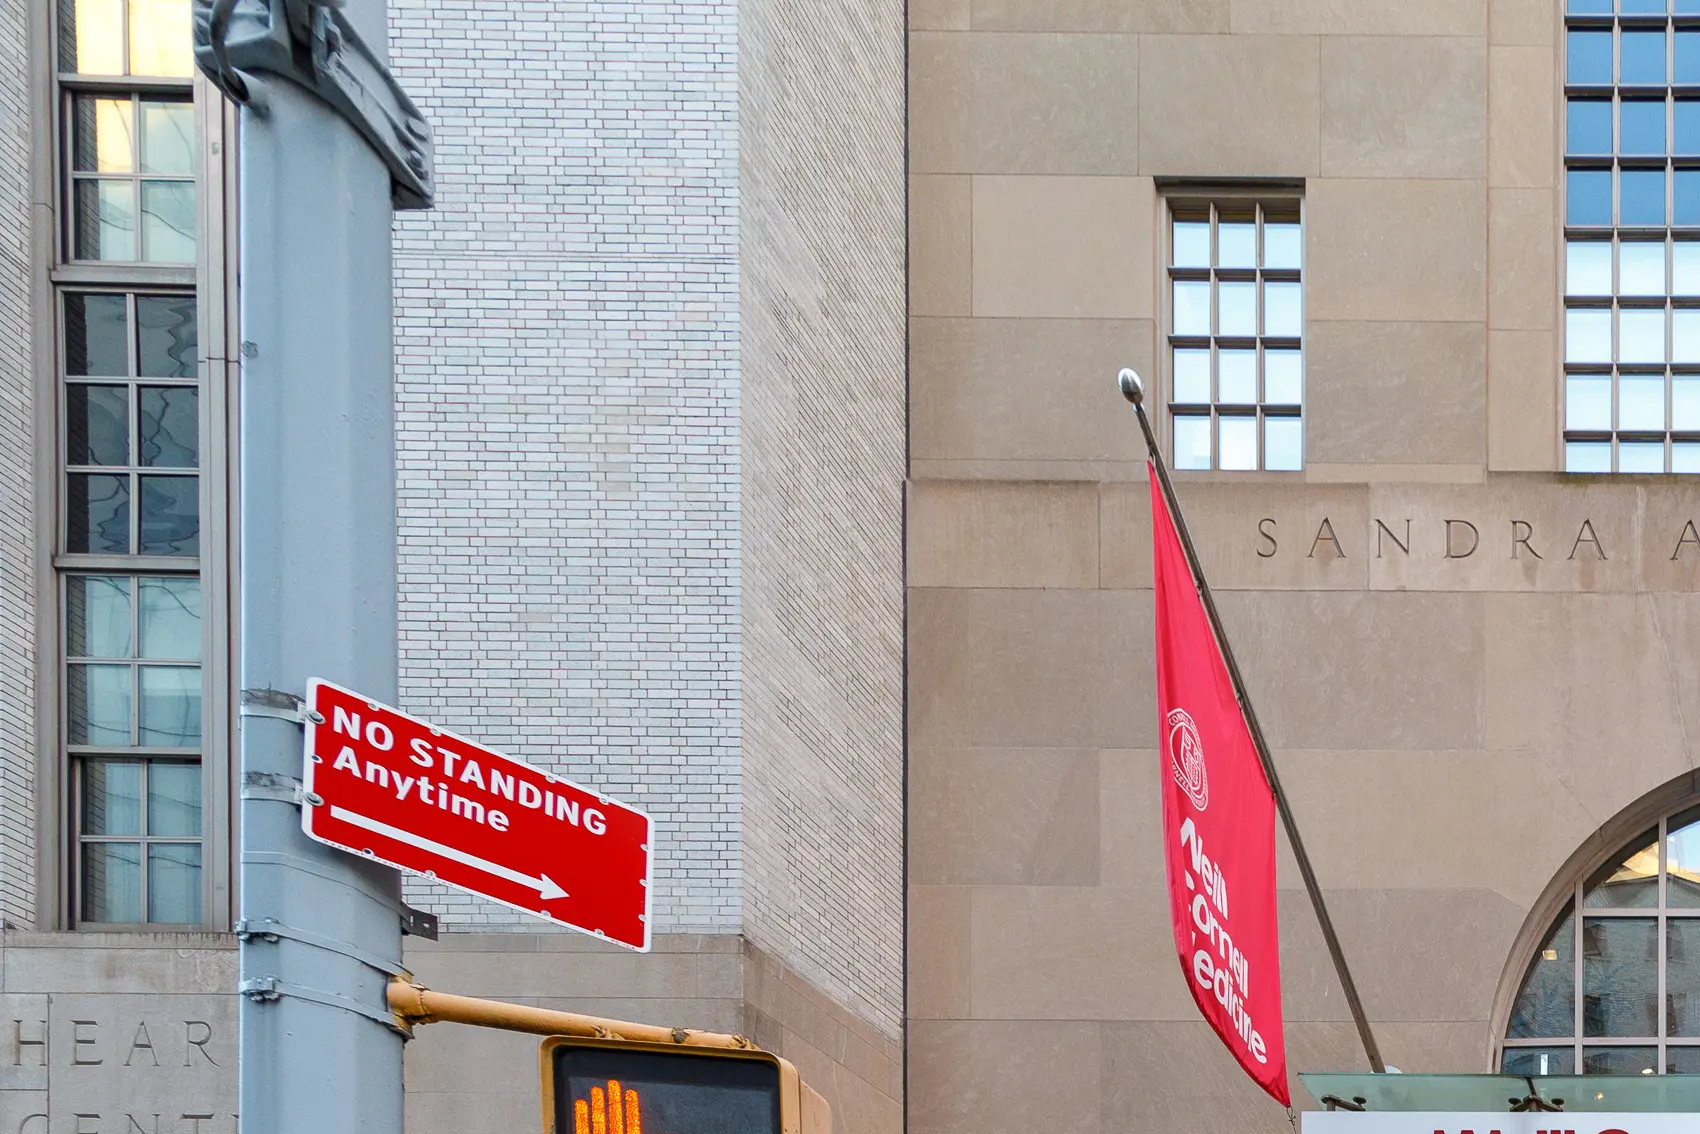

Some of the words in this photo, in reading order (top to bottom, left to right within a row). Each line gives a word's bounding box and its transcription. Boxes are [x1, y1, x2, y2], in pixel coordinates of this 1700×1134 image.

[1255, 517, 1609, 561] SANDRA
[333, 705, 394, 751] NO
[408, 738, 607, 836] STANDING
[333, 746, 510, 832] Anytime
[1185, 869, 1248, 998] ornell
[1192, 931, 1267, 1064] edicine
